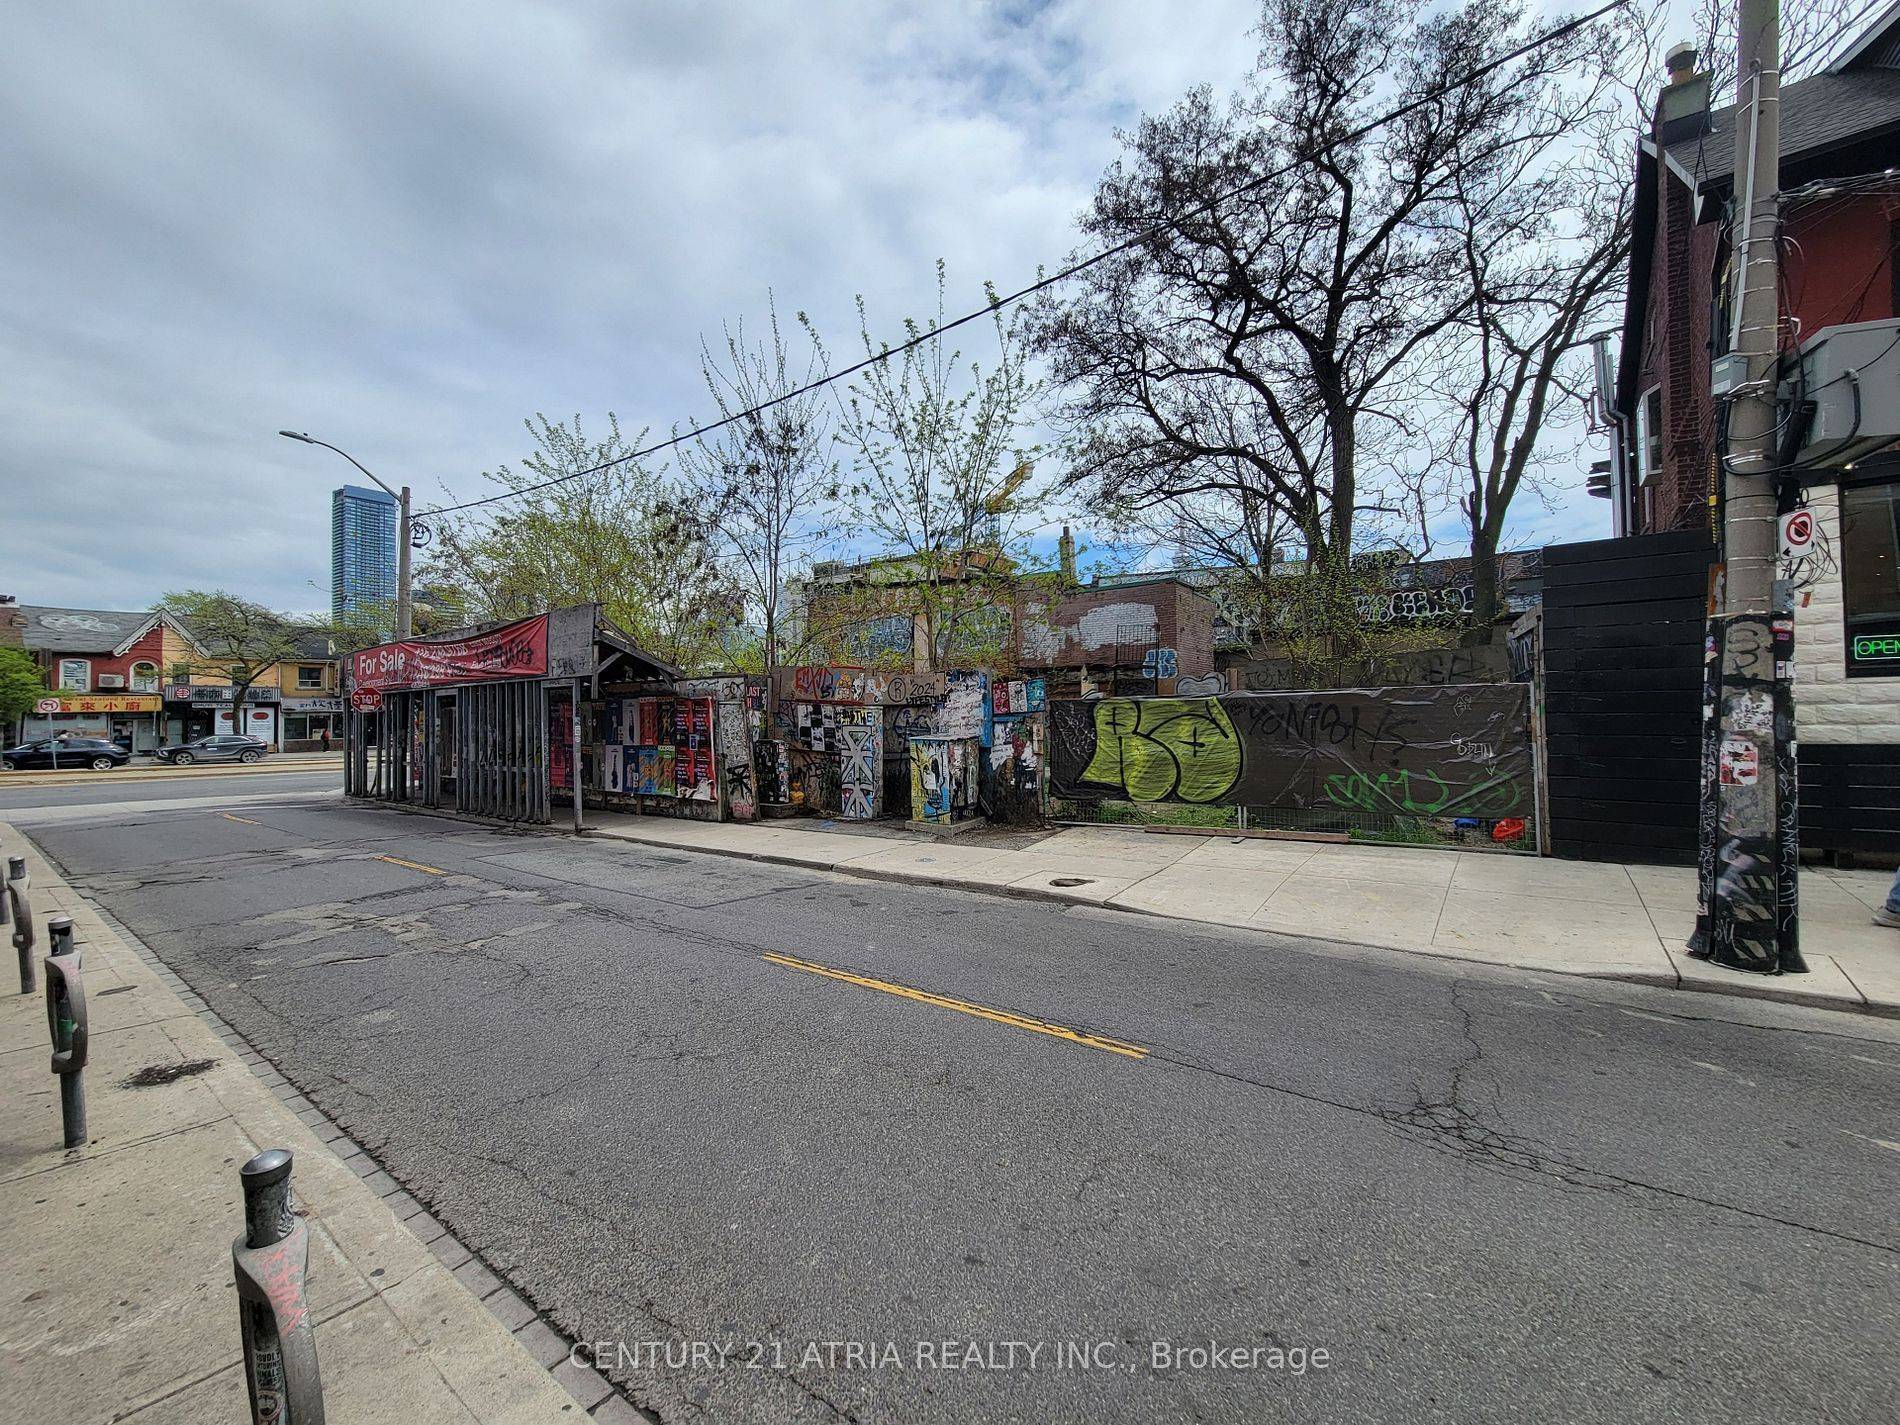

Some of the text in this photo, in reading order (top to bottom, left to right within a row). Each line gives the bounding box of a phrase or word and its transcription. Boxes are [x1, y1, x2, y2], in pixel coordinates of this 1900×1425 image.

[359, 653, 377, 676] For
[379, 648, 406, 673] Sale
[353, 694, 380, 705] STOP
